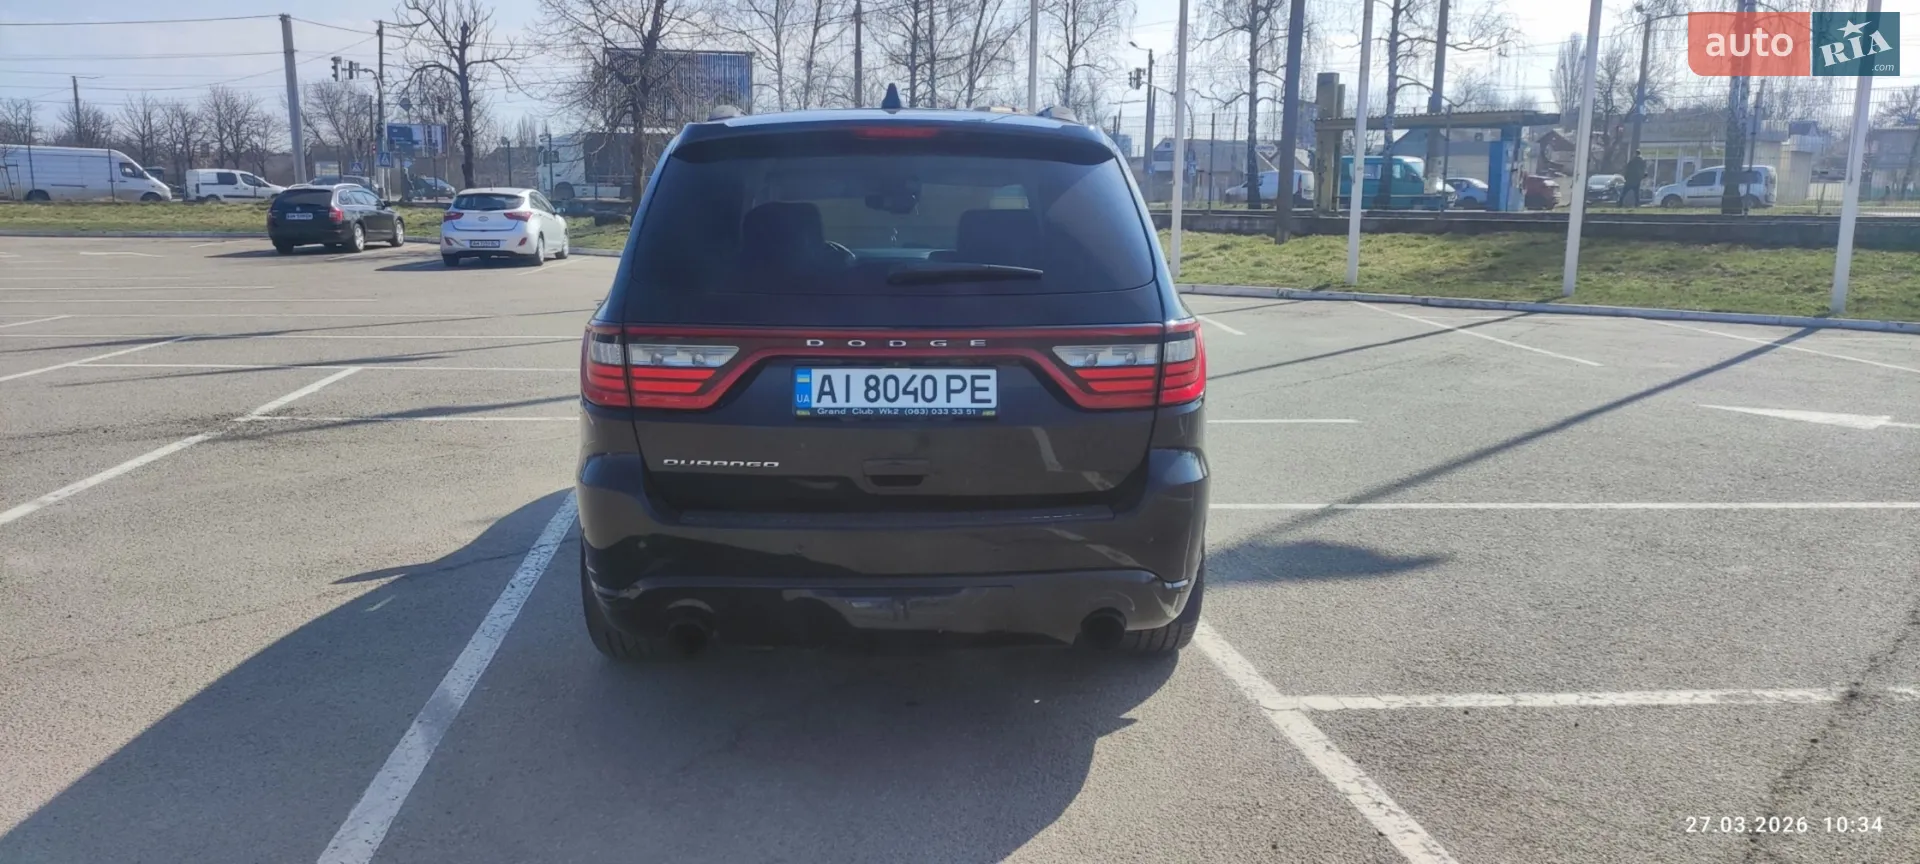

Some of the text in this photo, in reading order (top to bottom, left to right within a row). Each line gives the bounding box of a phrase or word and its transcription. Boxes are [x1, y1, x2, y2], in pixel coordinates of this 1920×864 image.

[806, 339, 986, 347] DODGE
[816, 374, 992, 404] AI 8040 PE
[796, 394, 810, 404] UA
[663, 459, 779, 467] DURANGO
